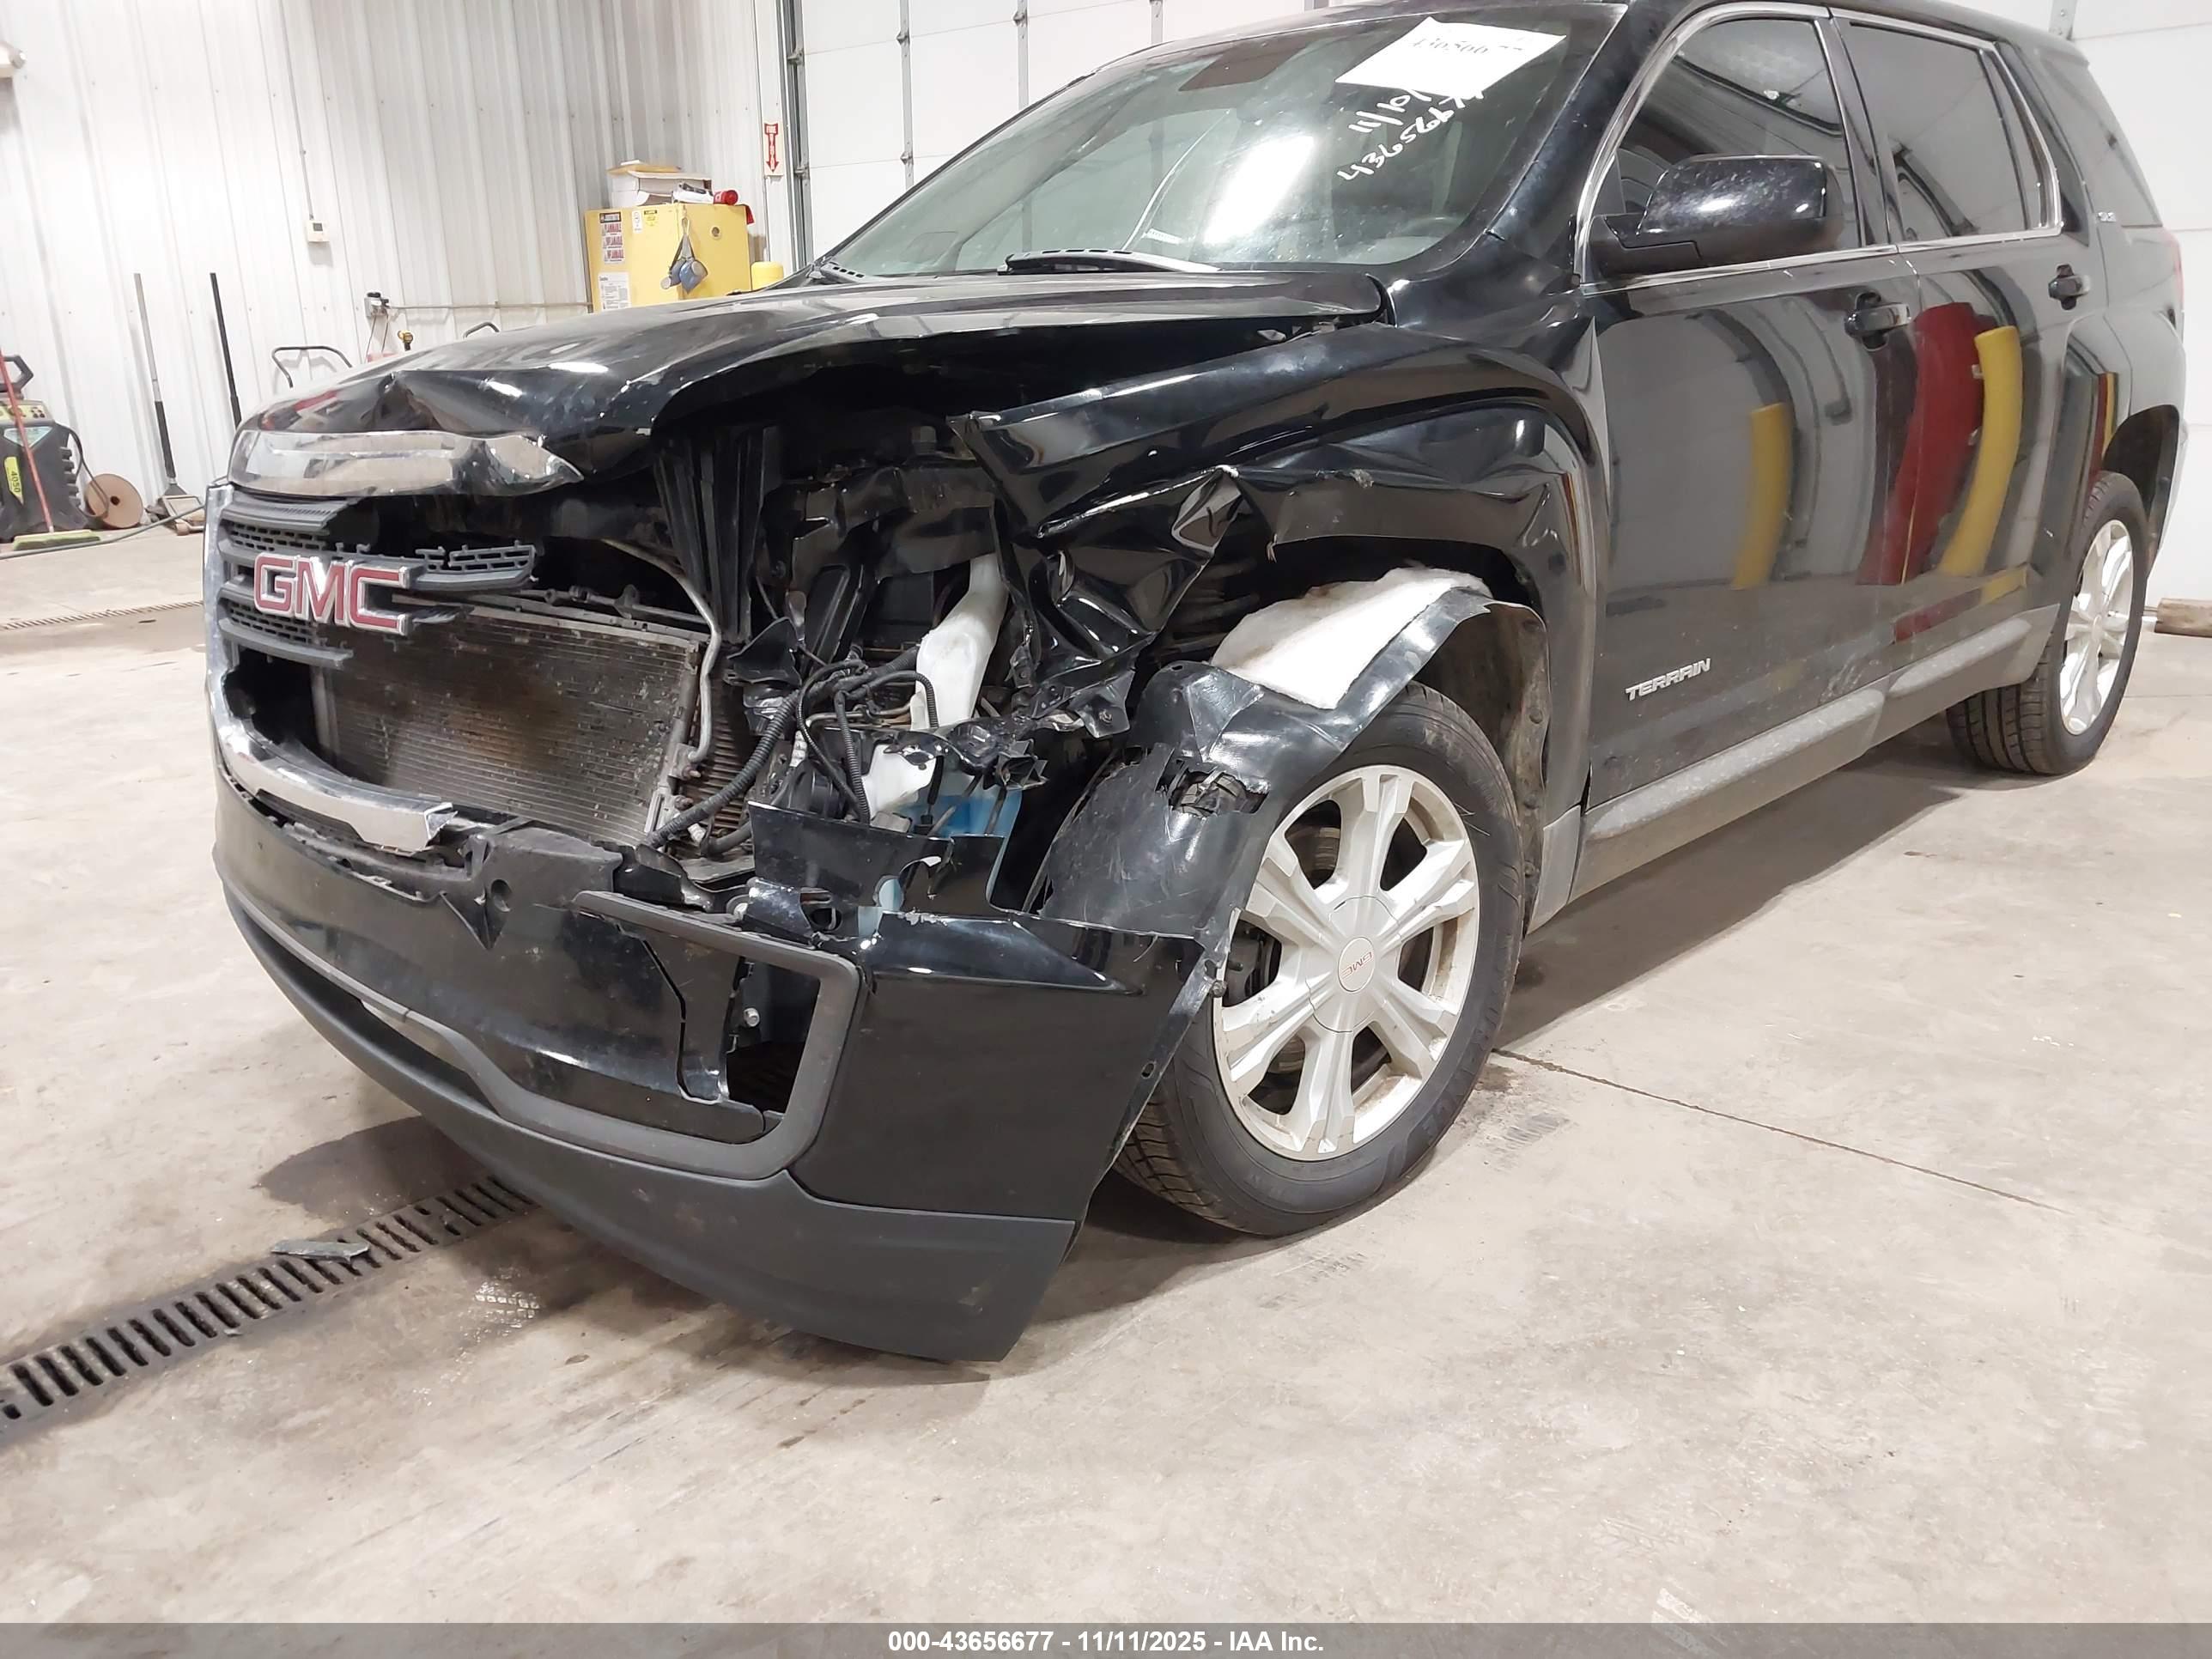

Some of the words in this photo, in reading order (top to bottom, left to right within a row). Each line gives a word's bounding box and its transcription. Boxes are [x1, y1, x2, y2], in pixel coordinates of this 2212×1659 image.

[11, 471, 21, 492] 4050
[254, 552, 410, 635] GMC
[1626, 658, 1711, 701] TERRAIN
[1341, 951, 1372, 979] GMC
